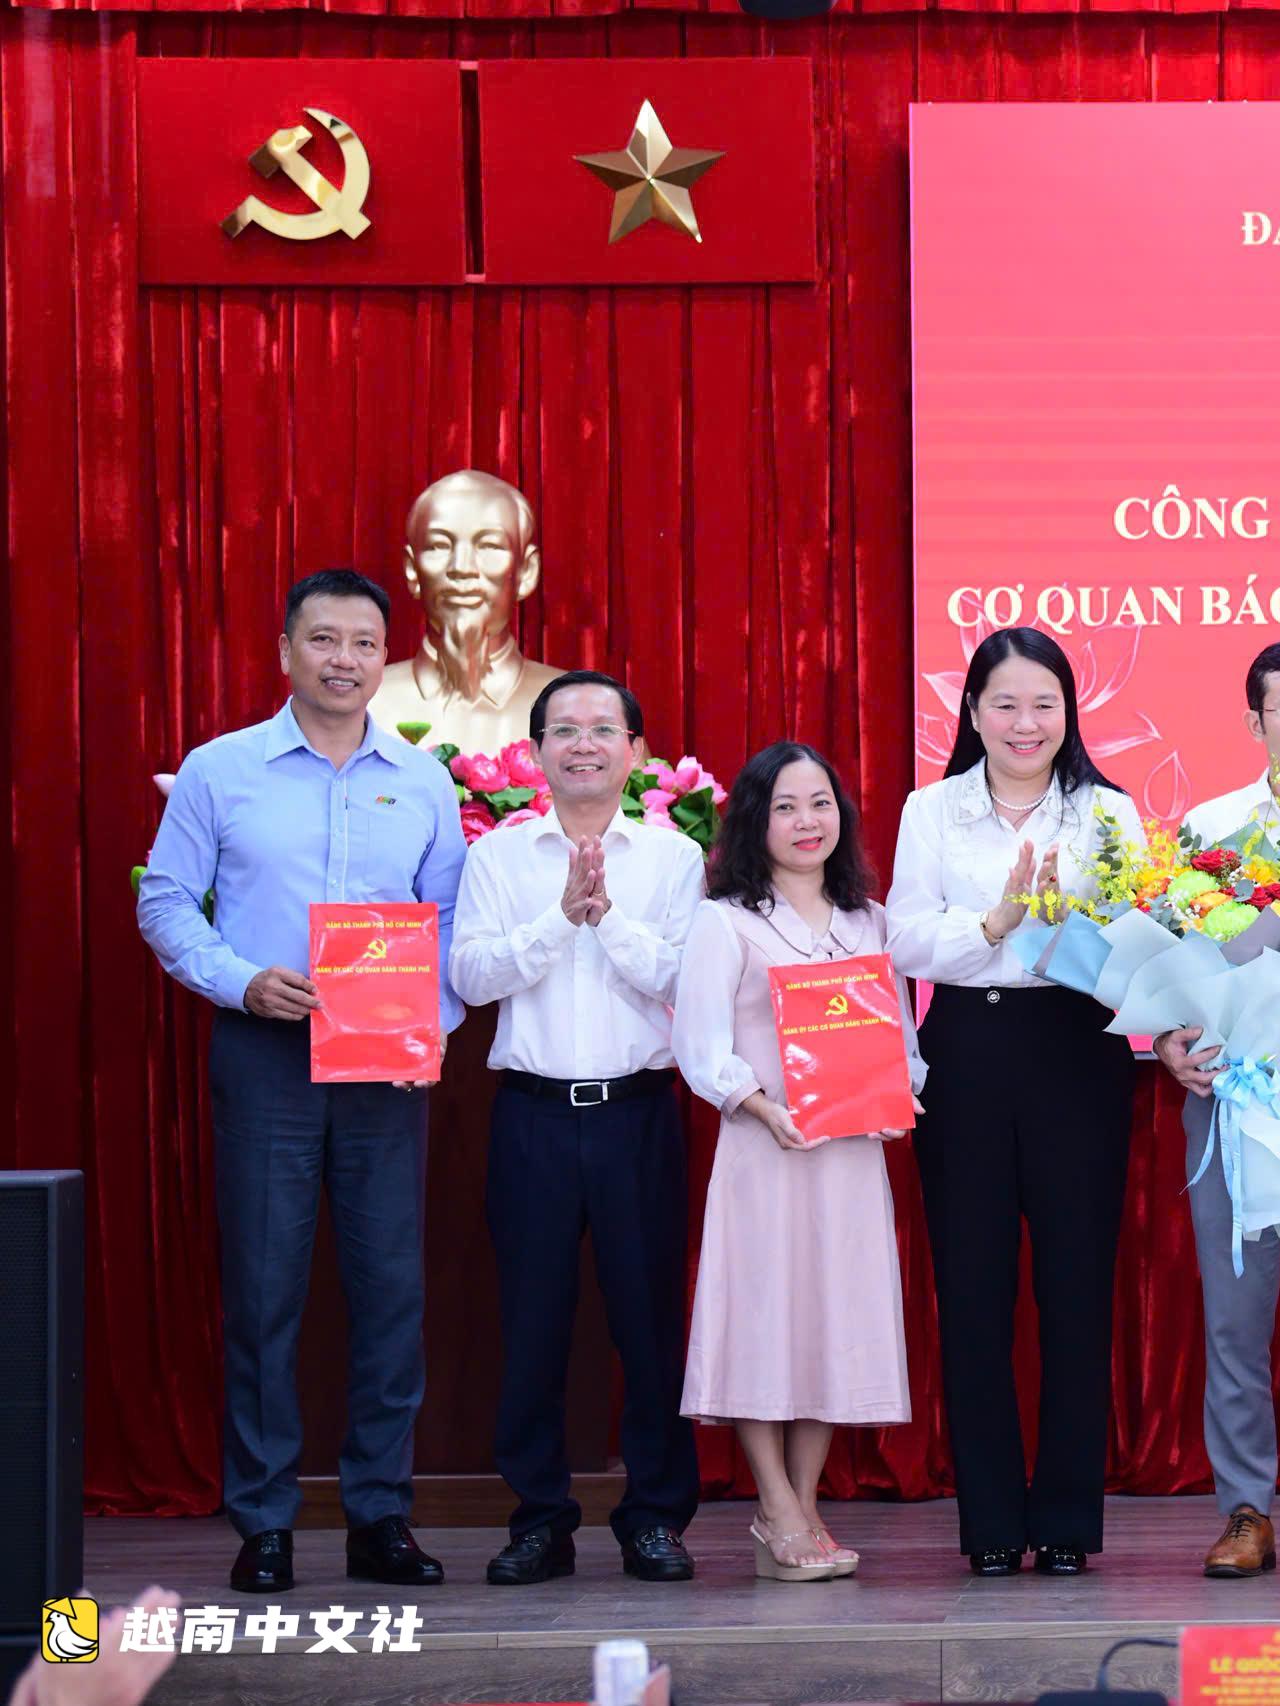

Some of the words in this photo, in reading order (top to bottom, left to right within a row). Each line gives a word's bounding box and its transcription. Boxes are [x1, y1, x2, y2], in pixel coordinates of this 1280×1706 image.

[1113, 484, 1270, 540] CÔNG
[947, 583, 1026, 628] CƠ
[1036, 585, 1184, 635] QUAN
